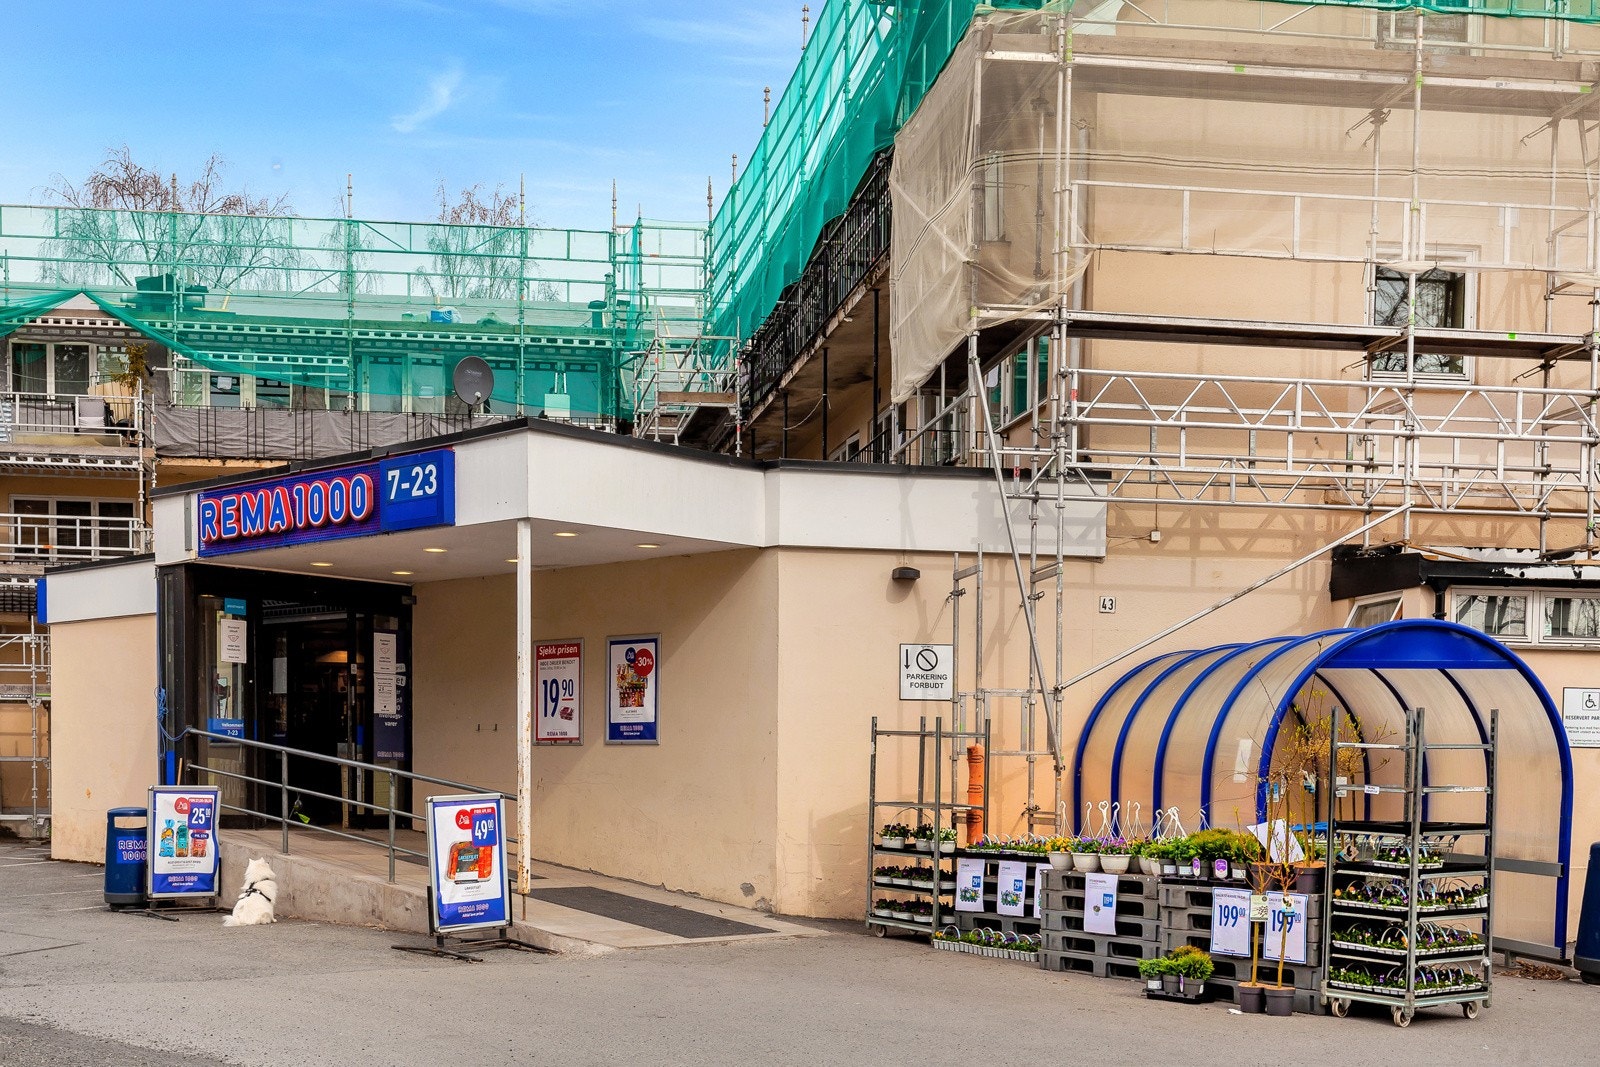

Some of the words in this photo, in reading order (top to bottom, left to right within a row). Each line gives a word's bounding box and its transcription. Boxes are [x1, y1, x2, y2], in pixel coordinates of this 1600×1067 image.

[387, 464, 437, 500] 7-23
[200, 485, 294, 544] REMA
[294, 473, 373, 529] 1000
[1101, 598, 1114, 611] 43
[538, 646, 557, 657] Sjekk
[557, 644, 578, 656] prisen
[635, 657, 653, 667] -30%
[906, 673, 948, 681] PARKERING
[909, 682, 944, 690] FORBUDT
[542, 678, 560, 718] 19
[561, 679, 574, 698] 90
[191, 807, 206, 825] 25
[474, 819, 488, 840] 49
[118, 840, 148, 851] REMA
[122, 850, 148, 861] 1000
[1218, 904, 1238, 927] 199
